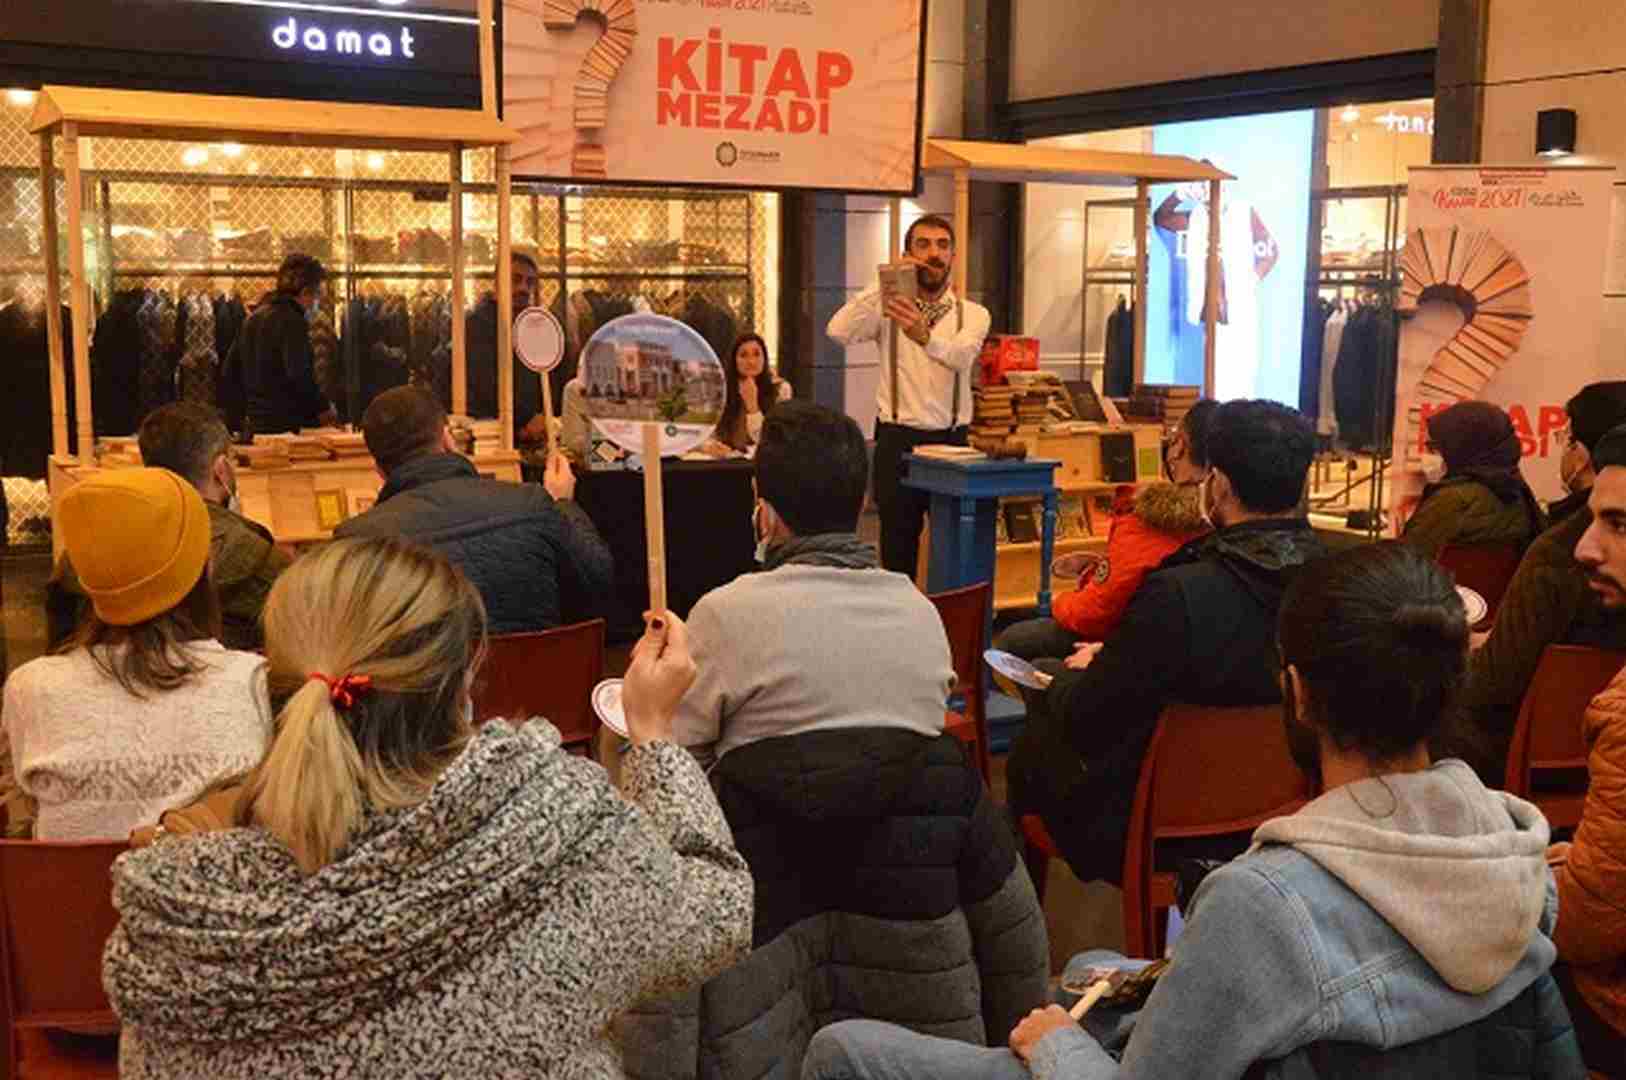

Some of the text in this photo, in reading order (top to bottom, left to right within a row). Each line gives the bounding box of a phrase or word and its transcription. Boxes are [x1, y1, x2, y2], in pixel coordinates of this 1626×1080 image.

[271, 16, 415, 59] damat
[656, 27, 854, 101] KİTAP
[656, 90, 830, 136] MEZADI
